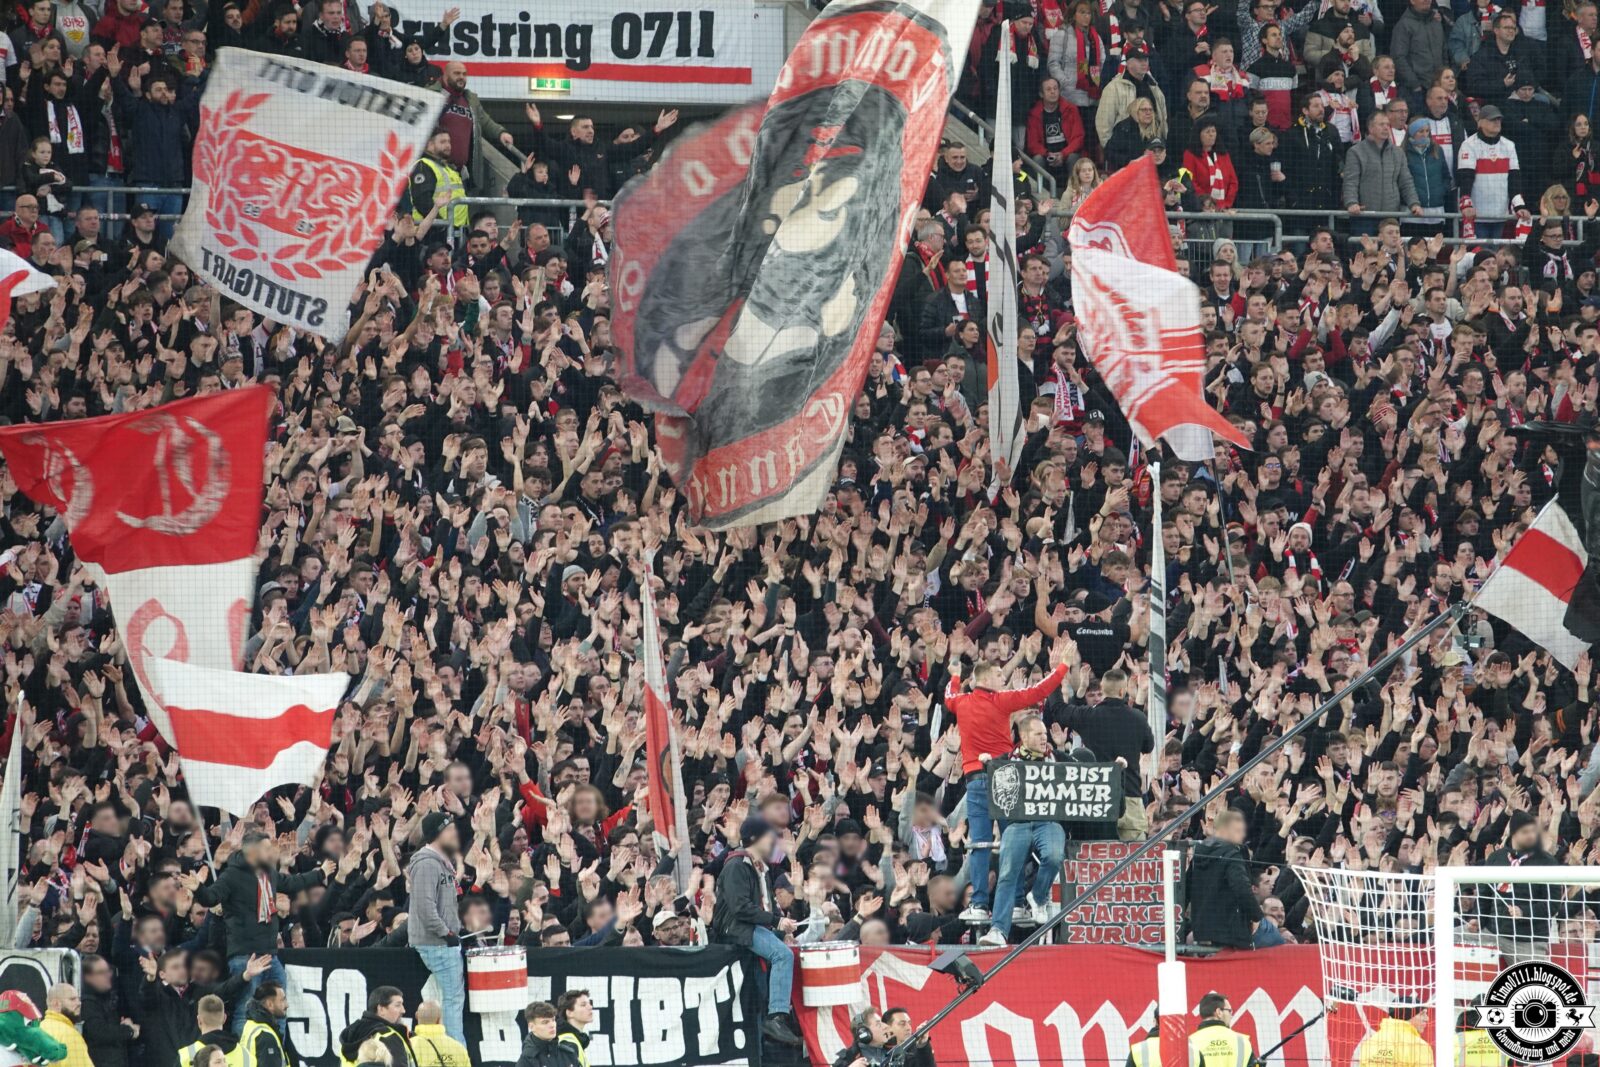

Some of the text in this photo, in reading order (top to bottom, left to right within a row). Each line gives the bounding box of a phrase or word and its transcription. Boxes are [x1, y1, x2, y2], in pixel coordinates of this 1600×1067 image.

[610, 10, 715, 59] 0711
[1025, 765, 1113, 781] DU BIST
[1025, 783, 1112, 802] IMMER
[1024, 802, 1112, 817] BEI UNS!
